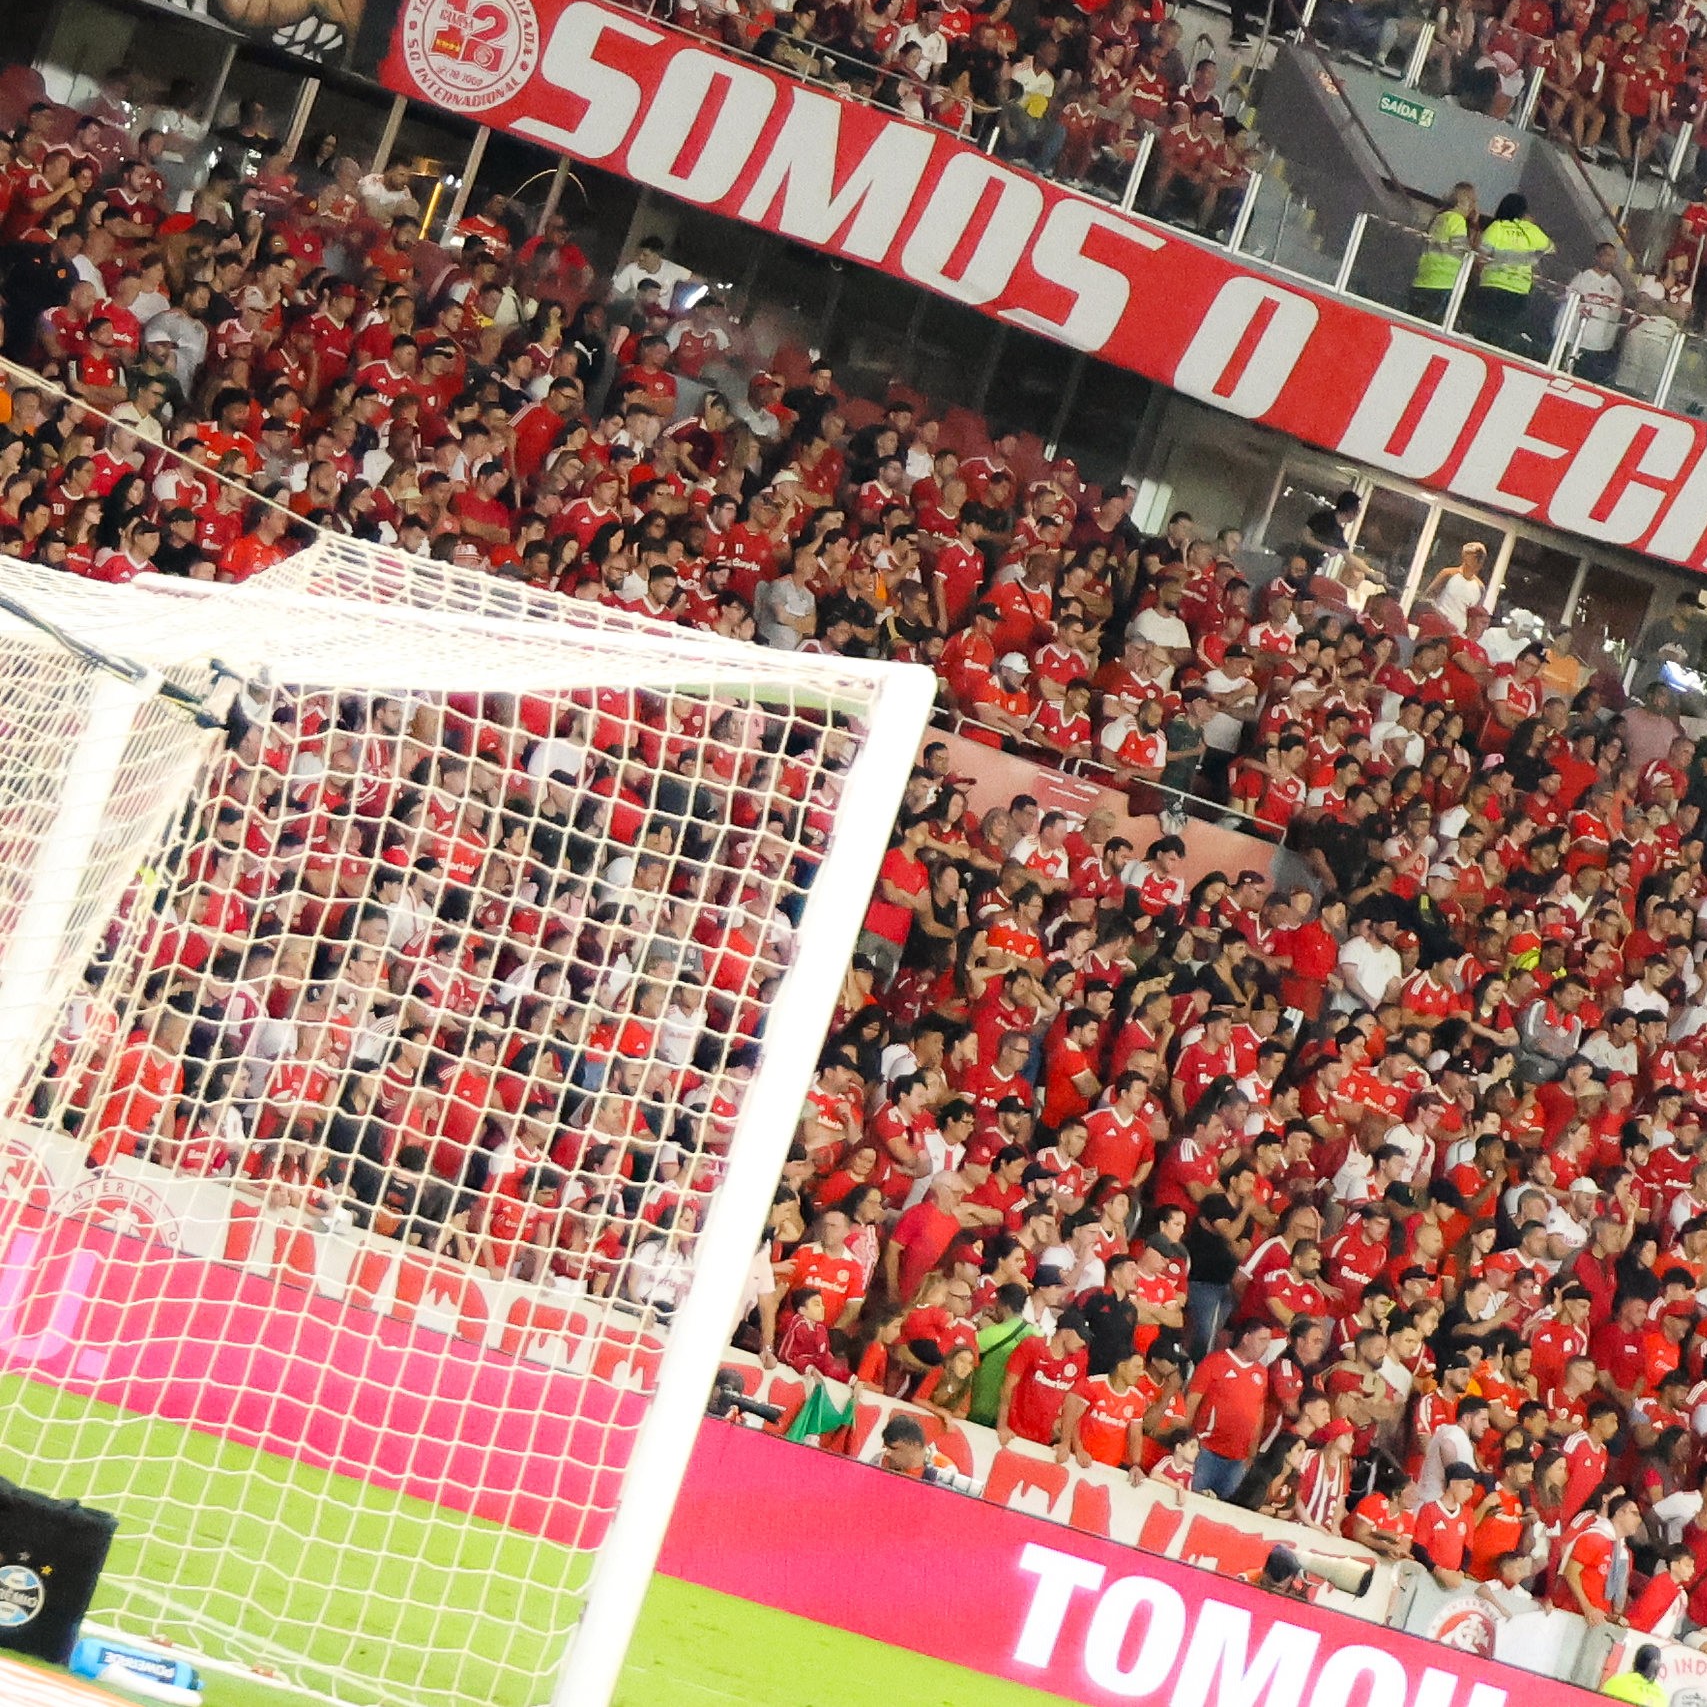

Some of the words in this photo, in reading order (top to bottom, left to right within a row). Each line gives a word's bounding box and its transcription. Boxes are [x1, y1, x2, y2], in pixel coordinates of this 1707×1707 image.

[511, 0, 1166, 353] SOMOS
[1174, 276, 1319, 420] O
[1380, 96, 1418, 122] SAÍDA
